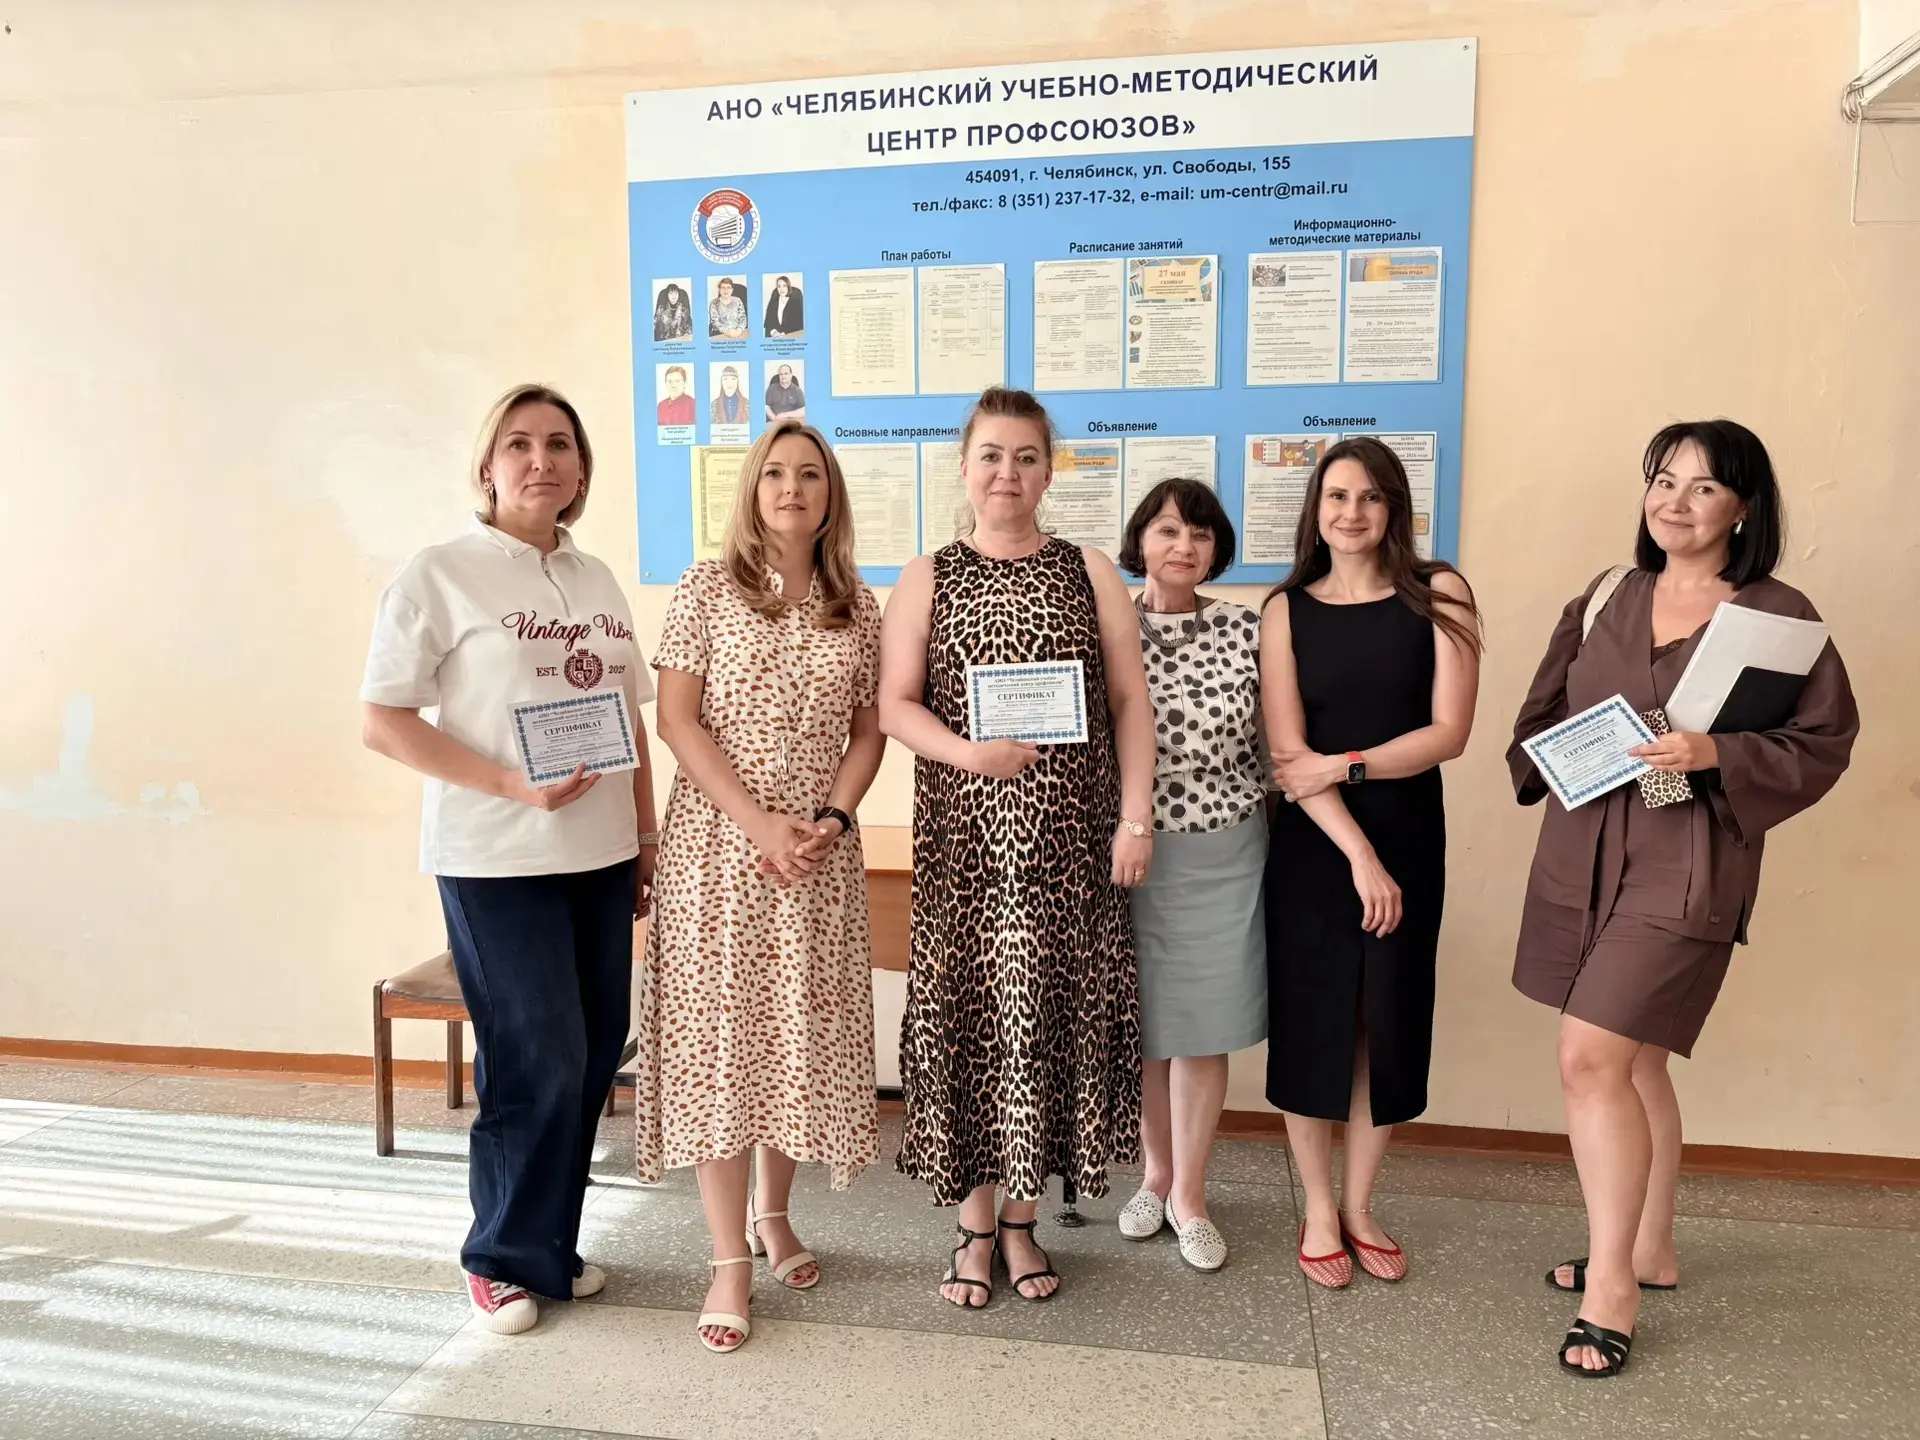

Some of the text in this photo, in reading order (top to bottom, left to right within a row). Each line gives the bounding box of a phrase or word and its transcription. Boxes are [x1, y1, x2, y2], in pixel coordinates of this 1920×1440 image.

[706, 53, 1379, 122] АНО «ЧЕЛЯБИНСКИЙ УЧЕБНО-МЕТОДИЧЕСКИЙ
[867, 114, 1196, 156] ЦЕНТР ПРОФСОЮЗОВ»
[965, 155, 1291, 184] 454091, г. Челябинск, ул. Свободы, 155
[912, 181, 1348, 214] тел./факс: 8 (351) 237-17-32, e-mail: um-centr@mail.ru
[1293, 218, 1397, 233] Информационно-
[1069, 238, 1183, 254] Расписание занятий
[1269, 231, 1421, 247] методические материалы
[881, 248, 951, 263] План работы
[1087, 421, 1158, 433] Объявление
[1301, 415, 1377, 428] Объявление
[834, 426, 960, 439] Основные направления
[501, 610, 592, 652] Vintage
[535, 666, 559, 677] EST.
[997, 691, 1056, 701] СЕРТИФИКАТ
[544, 719, 603, 737] СЕРТИФИКАТ
[1563, 729, 1617, 760] СЕРТИФИКАТ
